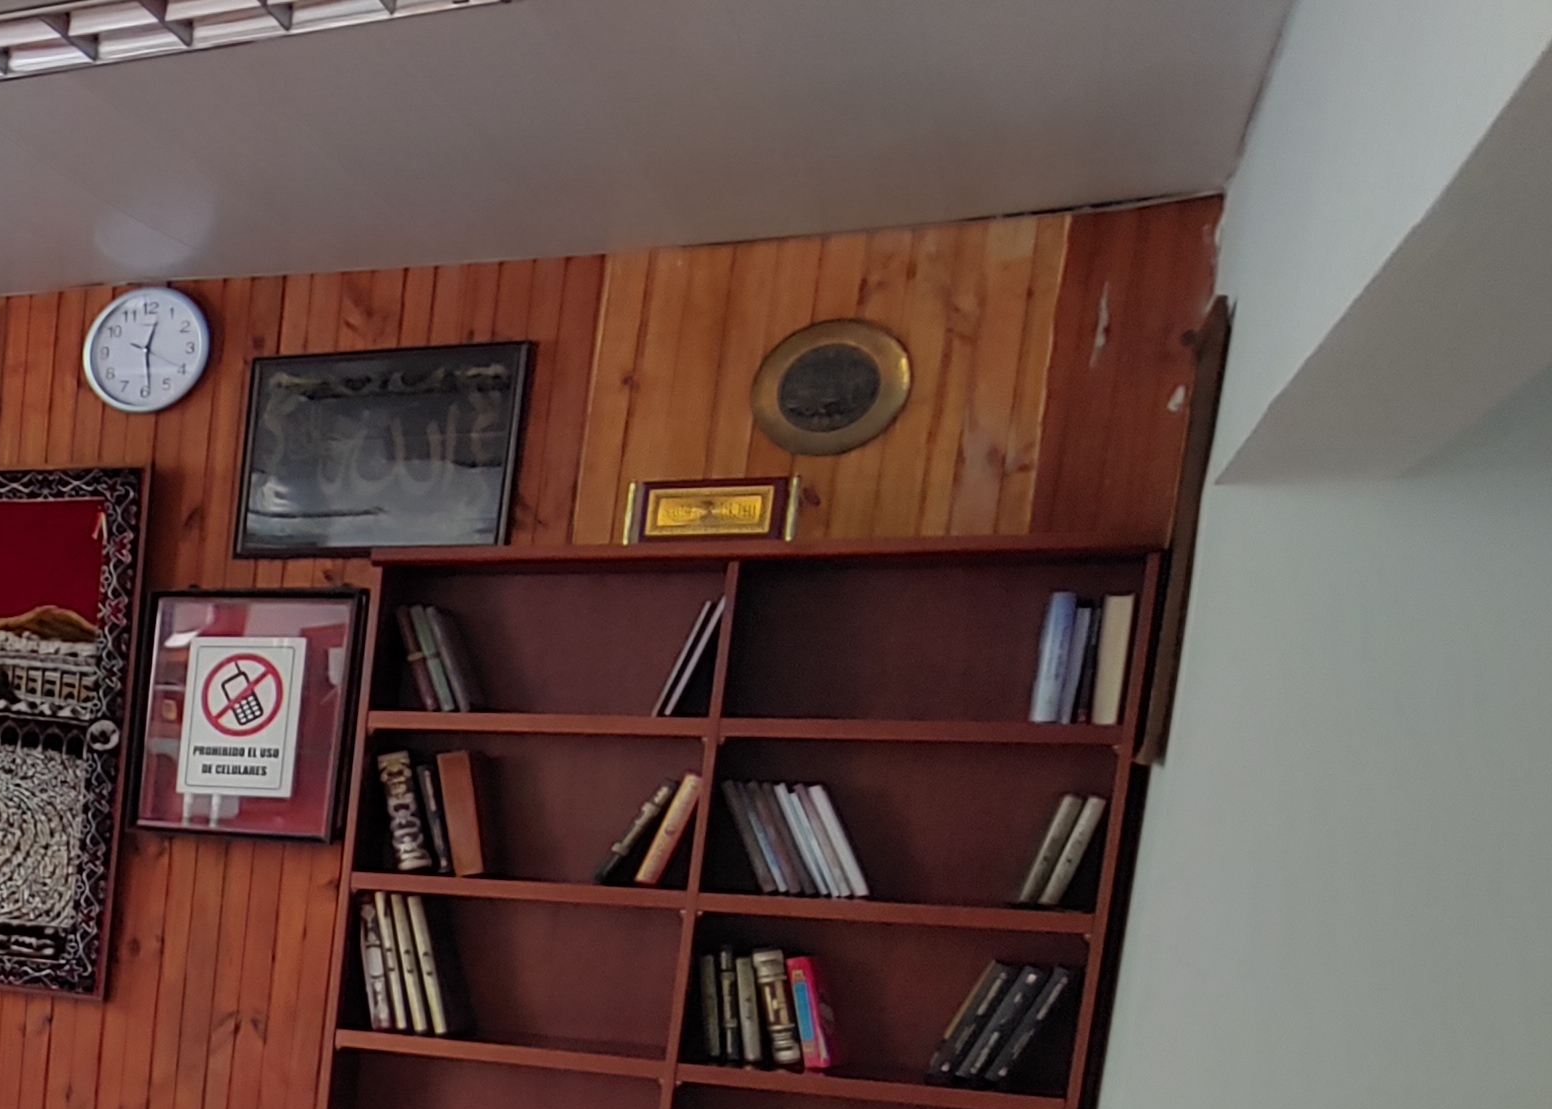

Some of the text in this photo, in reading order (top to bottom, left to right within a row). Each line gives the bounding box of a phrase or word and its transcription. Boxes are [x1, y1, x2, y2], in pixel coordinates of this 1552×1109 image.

[143, 301, 159, 315] 12
[122, 310, 137, 322] 11
[108, 325, 122, 338] 10
[179, 320, 191, 333] 2
[100, 346, 110, 359] 9
[185, 342, 195, 354] 3
[105, 368, 115, 380] 8
[177, 363, 187, 375] 4
[119, 380, 129, 392] 7
[162, 378, 172, 391] 5
[140, 385, 151, 398] 6
[193, 746, 280, 758] PROHIBIDO EL USO
[201, 763, 267, 776] DE CELULARES
